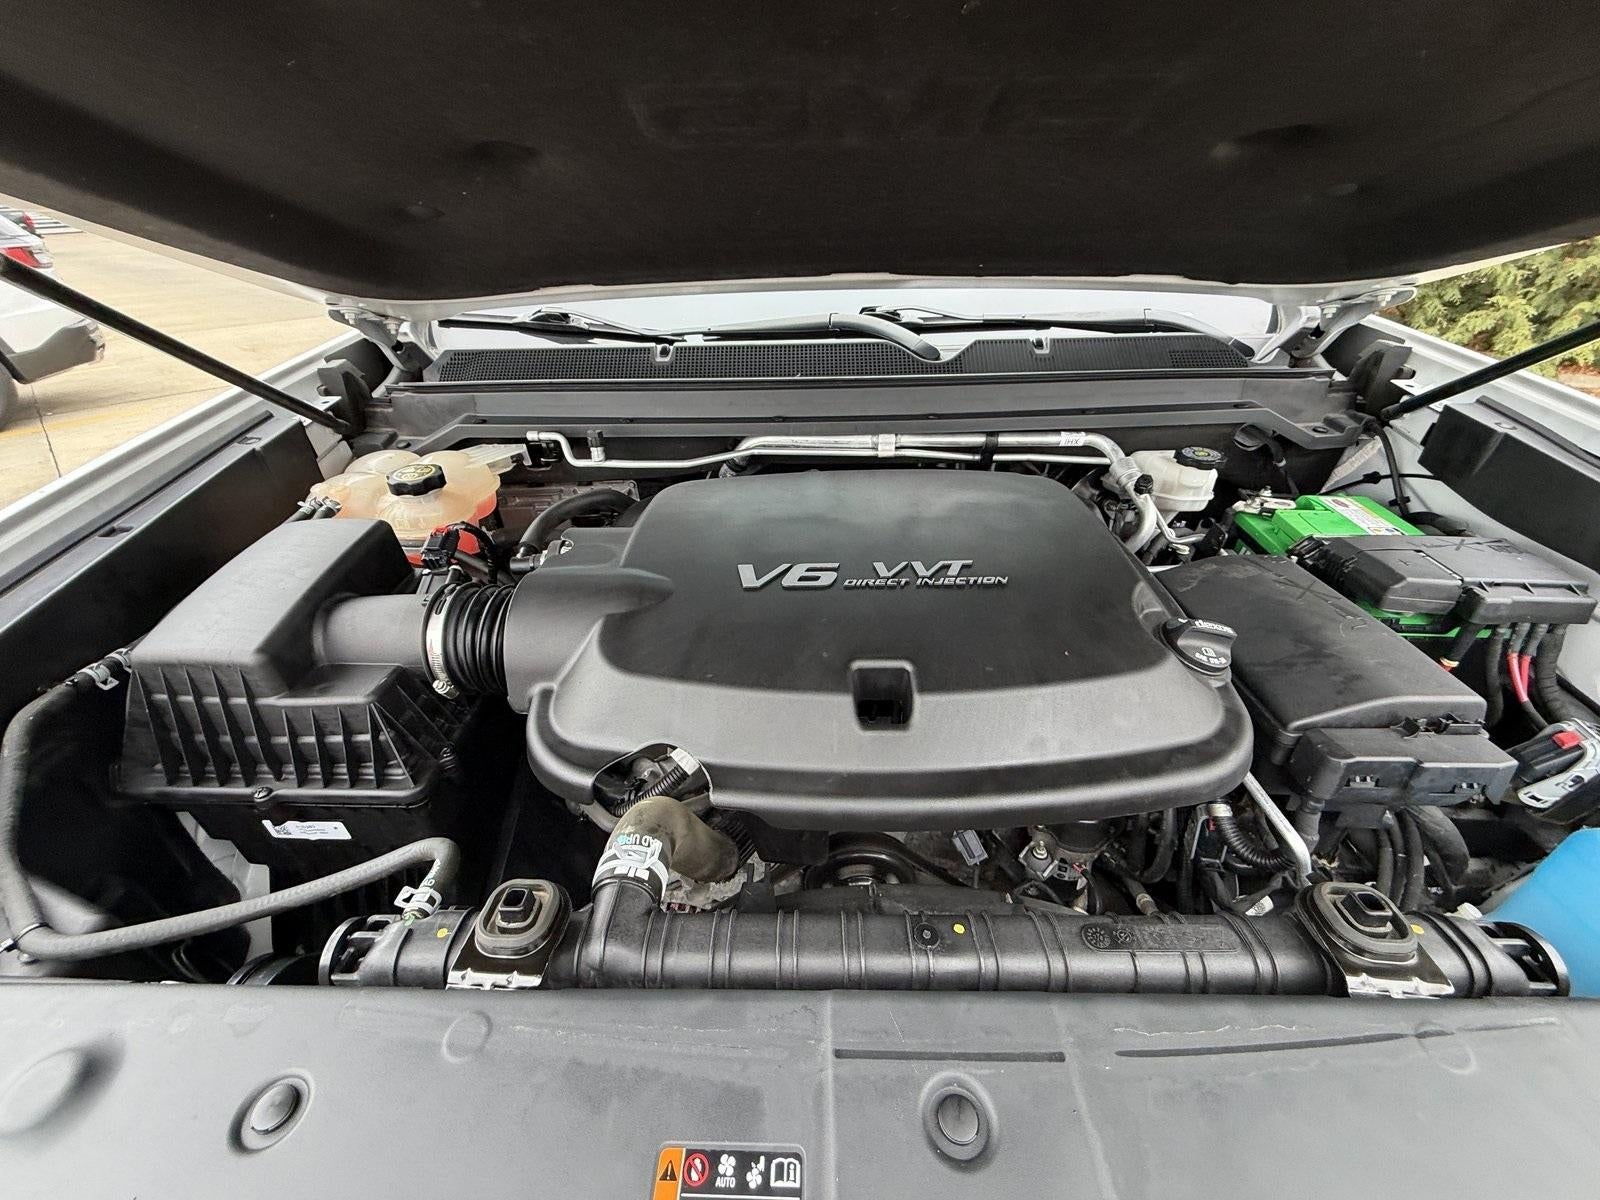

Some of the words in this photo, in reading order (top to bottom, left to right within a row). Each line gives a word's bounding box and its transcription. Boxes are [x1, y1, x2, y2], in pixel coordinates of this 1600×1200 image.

[737, 562, 841, 588] V6
[872, 559, 974, 578] VVT
[843, 577, 908, 588] DIRECT
[915, 575, 1009, 587] INJECTION
[715, 1177, 736, 1188] AUTO
